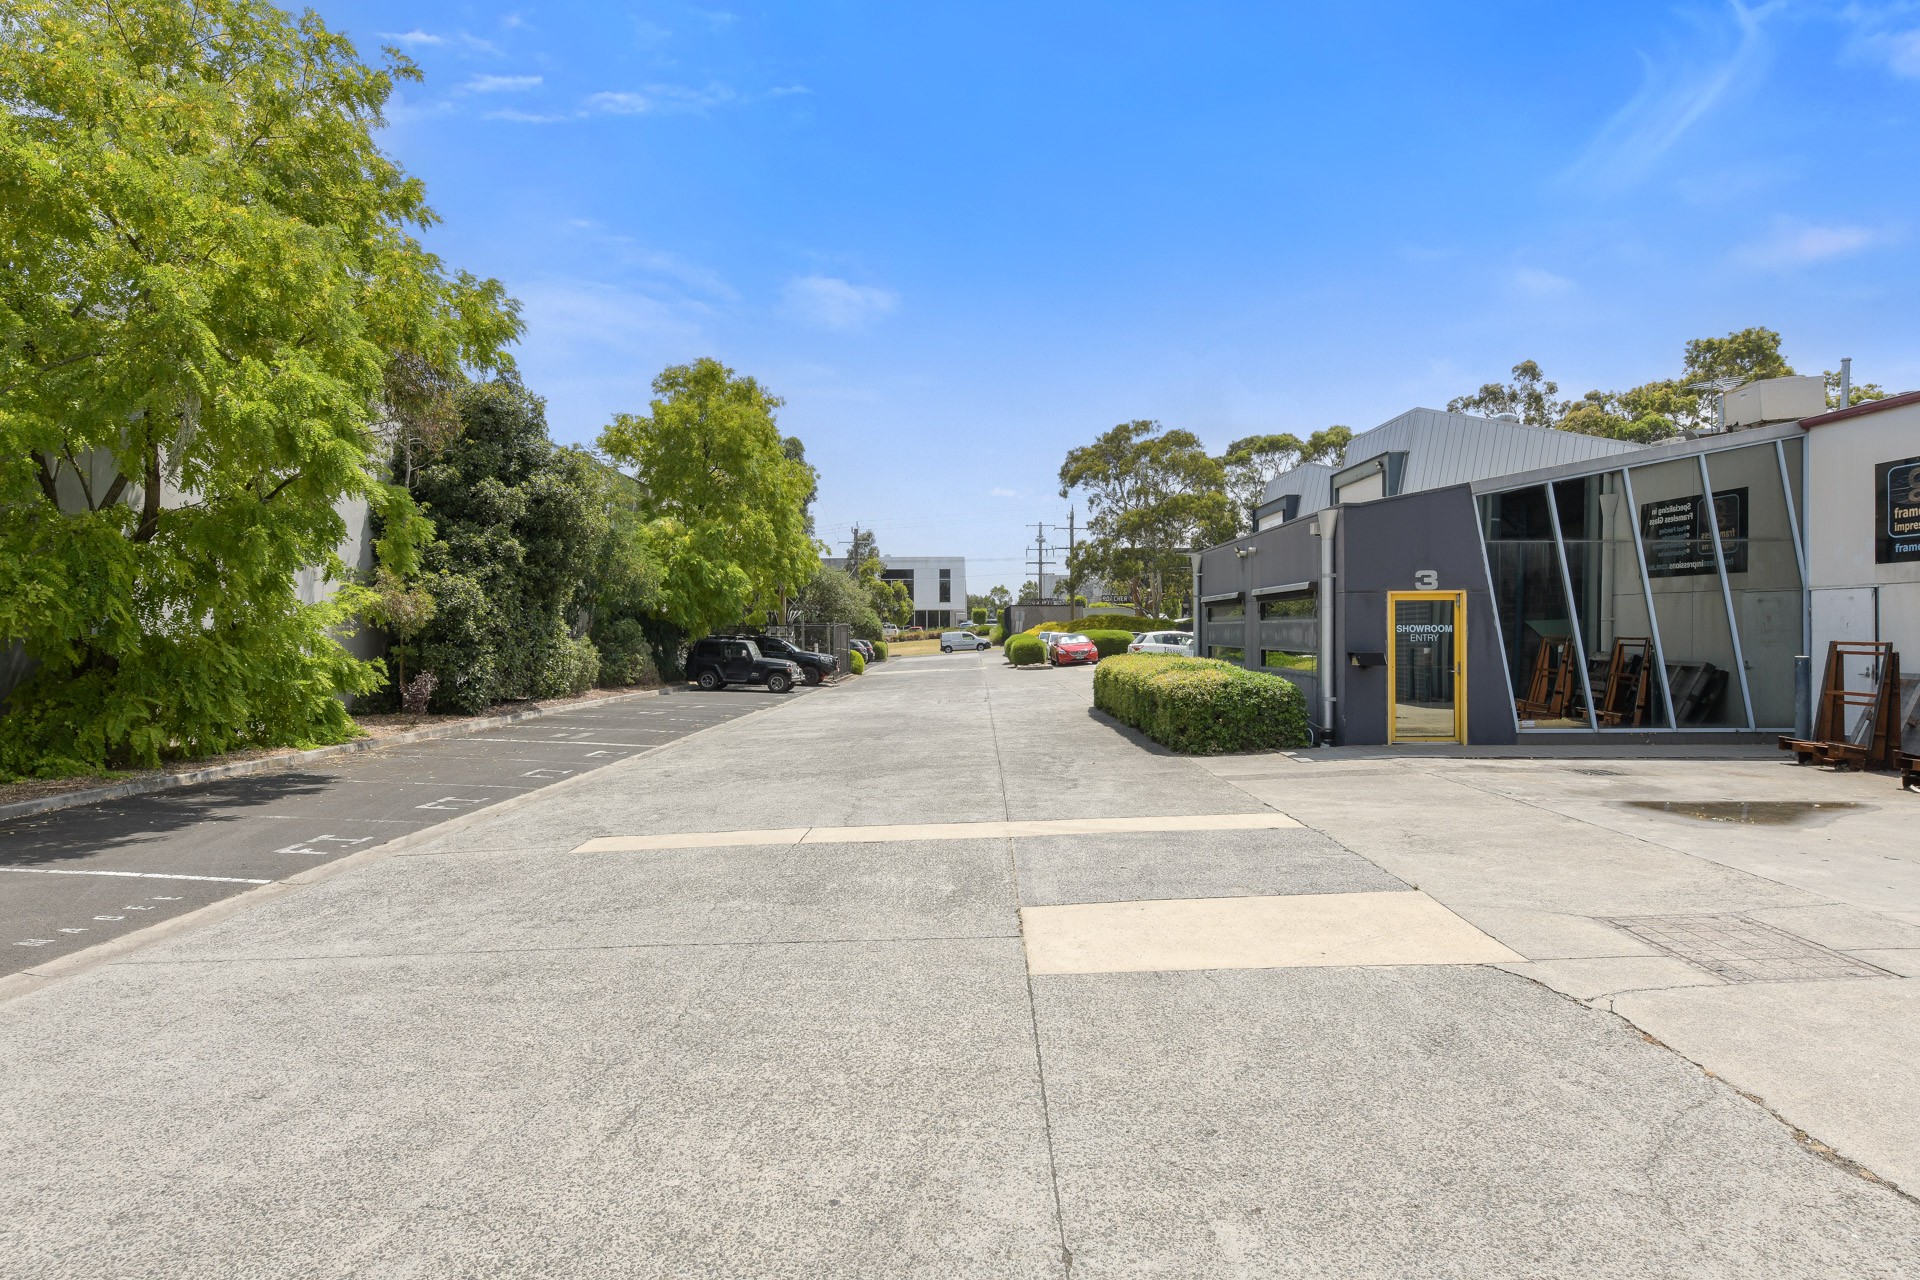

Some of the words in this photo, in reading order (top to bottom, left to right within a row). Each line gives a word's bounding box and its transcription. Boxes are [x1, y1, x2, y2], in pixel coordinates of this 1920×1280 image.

[1414, 570, 1439, 590] 3
[1396, 624, 1453, 633] SHOWROOM
[1410, 633, 1439, 642] ENTRY
